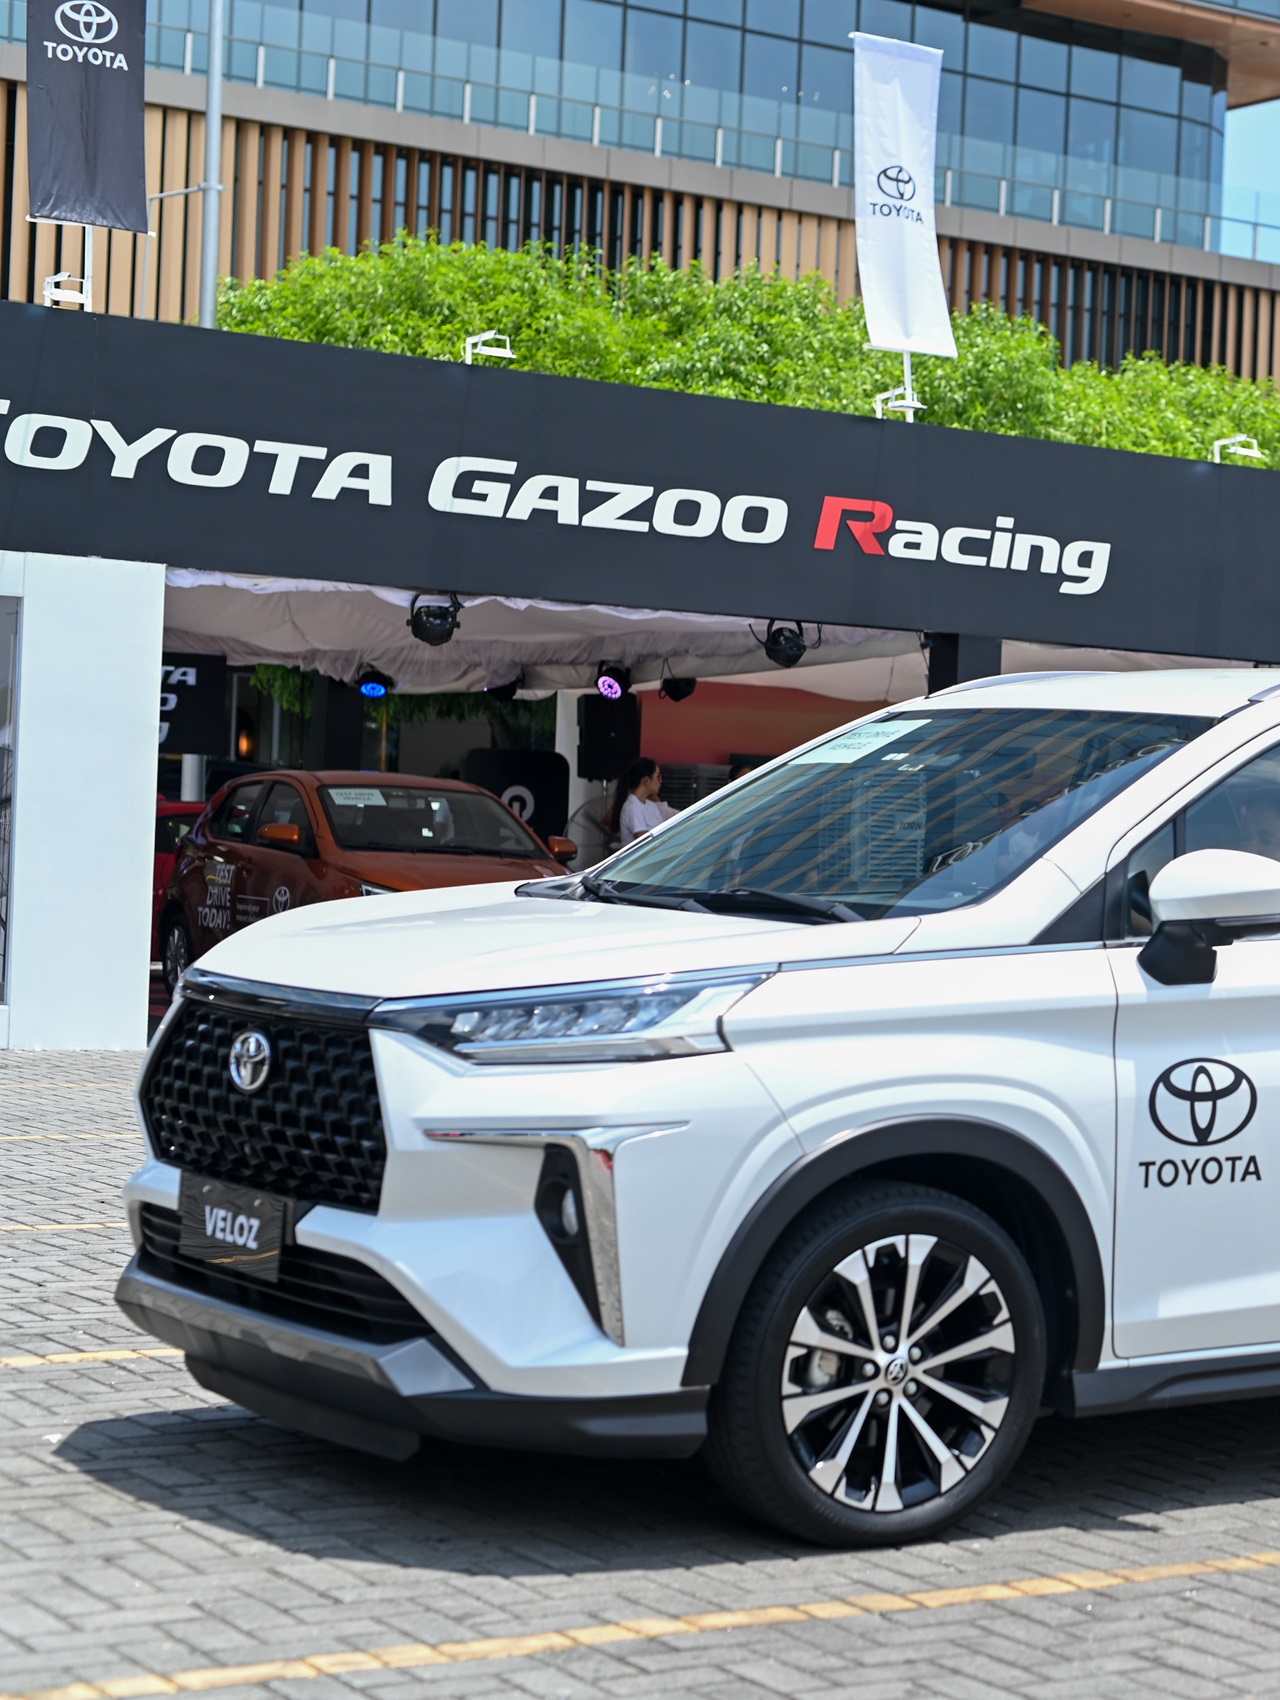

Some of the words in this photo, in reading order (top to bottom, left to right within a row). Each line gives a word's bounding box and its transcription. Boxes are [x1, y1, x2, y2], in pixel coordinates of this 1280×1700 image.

[43, 41, 129, 71] TOYOTA
[869, 203, 924, 225] TOYOTA
[0, 399, 392, 506] OYOTA
[427, 456, 789, 545] GAZOO
[813, 495, 1112, 596] Racing
[215, 864, 235, 885] TEST
[206, 886, 231, 907] DRIVE
[197, 906, 231, 930] TODAY!
[1138, 1155, 1262, 1188] TOYOTA
[204, 1205, 261, 1250] VELOZ
